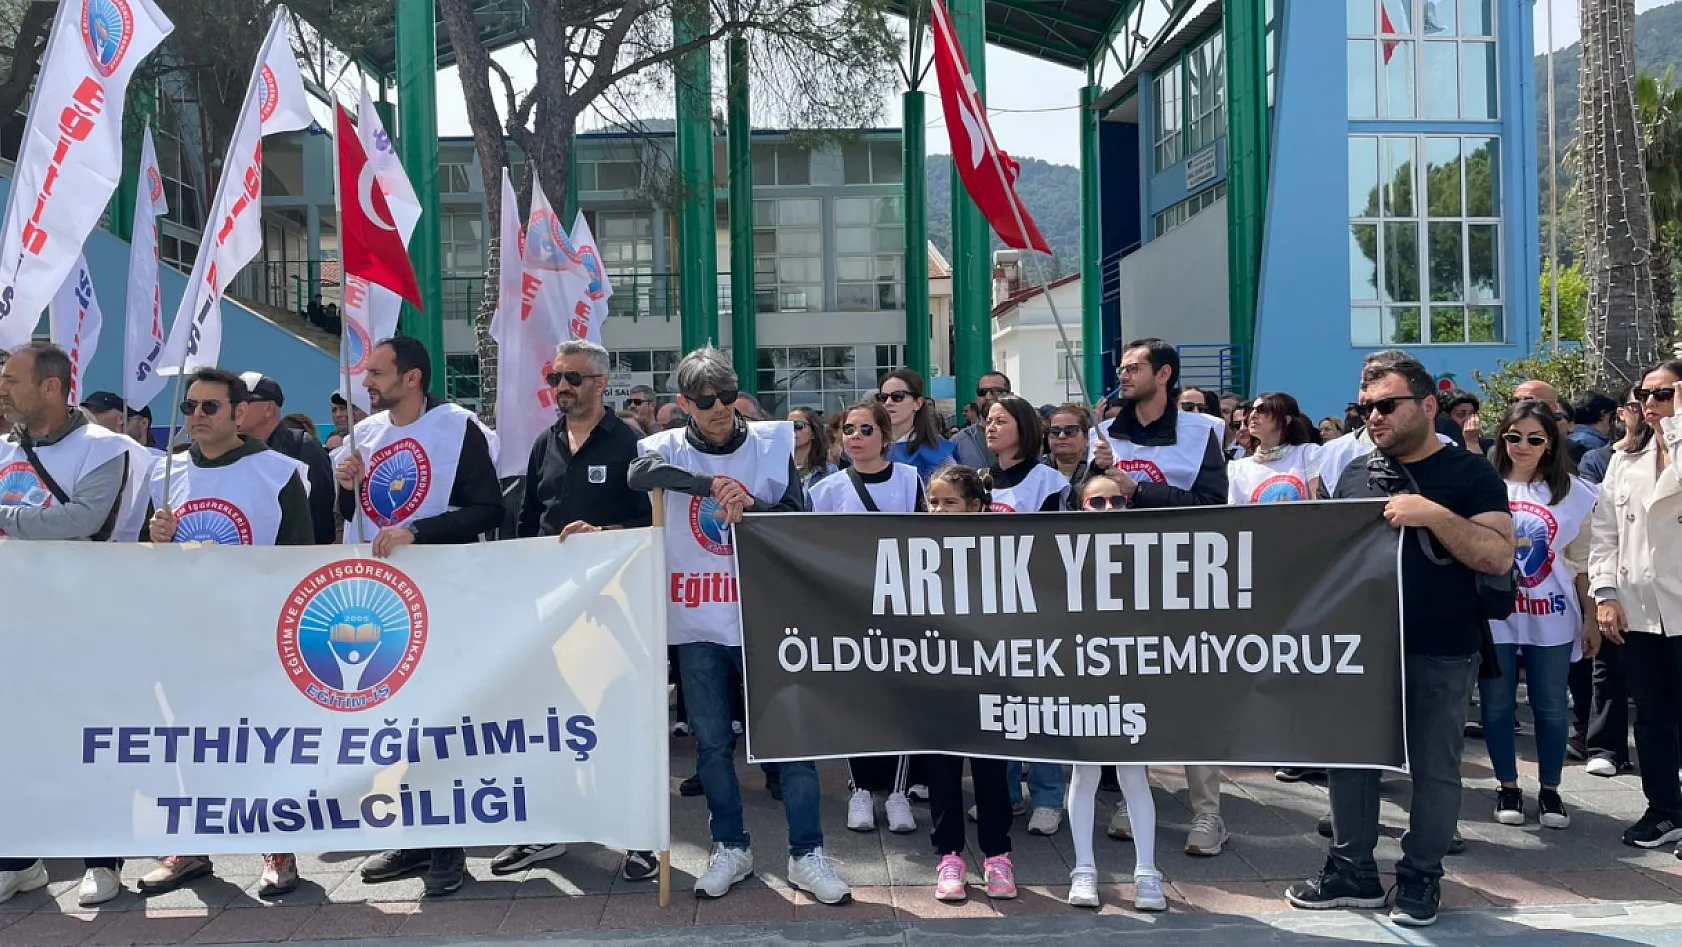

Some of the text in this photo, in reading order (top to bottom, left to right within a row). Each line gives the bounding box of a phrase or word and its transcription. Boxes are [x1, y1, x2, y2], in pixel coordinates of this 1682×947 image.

[294, 574, 326, 604] BİLİM
[329, 563, 417, 601] İŞGÖRENLERİ
[671, 572, 739, 609] Eğiti
[873, 530, 1253, 616] ARTIK YETER!
[285, 608, 298, 624] VE
[1512, 591, 1566, 616] timiş
[281, 628, 303, 675] EĞİTİM
[777, 627, 1066, 678] ÖLDÜRÜLMEK
[306, 683, 391, 709] EĞİTİM-İŞ
[82, 706, 598, 766] FETHİYE EĞİTİM-İŞ
[978, 694, 1147, 745] Eğitimiş
[157, 776, 527, 835] TEMSİLCİLİĞİ
